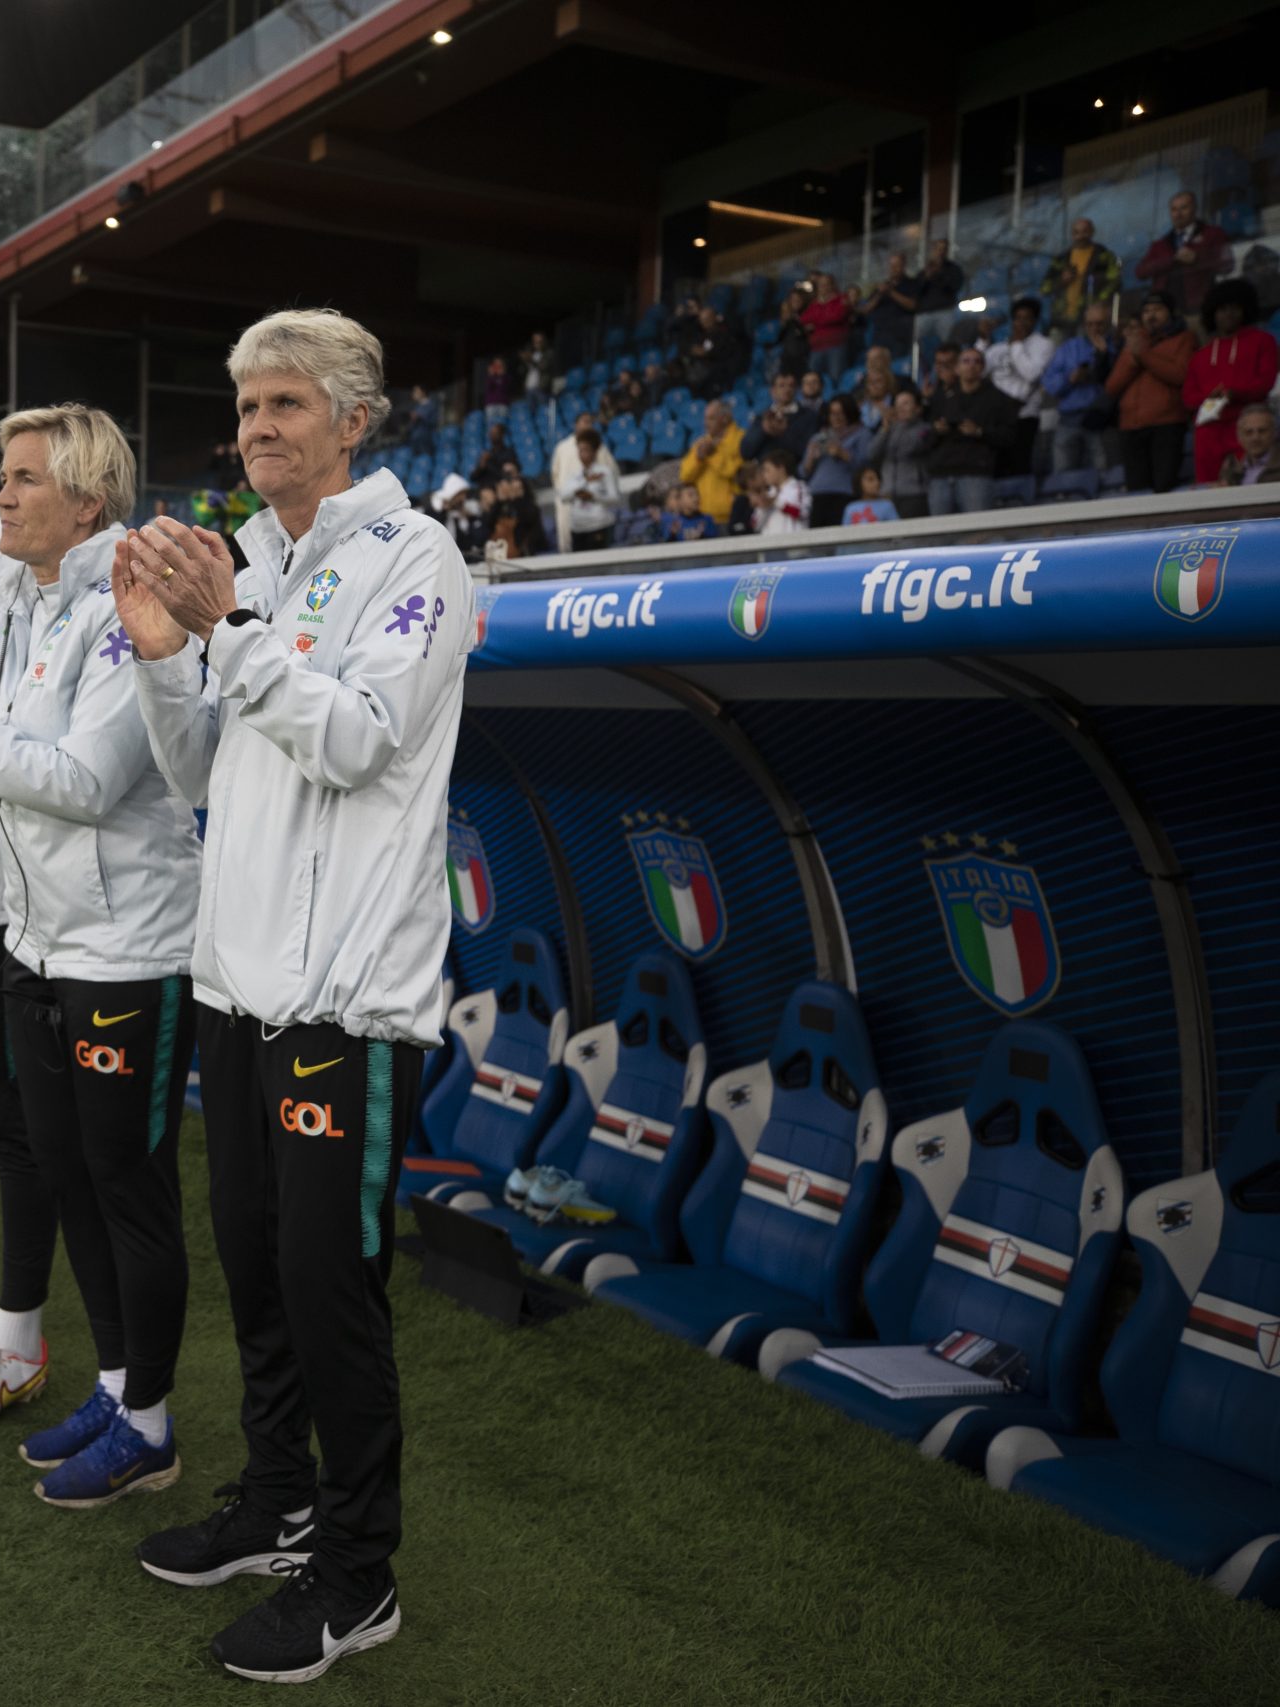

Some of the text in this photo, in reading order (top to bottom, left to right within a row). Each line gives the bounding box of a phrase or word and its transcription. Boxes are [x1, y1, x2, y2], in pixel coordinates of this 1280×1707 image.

[1169, 539, 1227, 554] ITALIA
[861, 550, 1041, 623] figc.it
[297, 613, 324, 624] BRASIL
[546, 580, 663, 639] figc.it
[636, 840, 701, 862] ITALIA
[939, 868, 1031, 897] ITALIA
[75, 1040, 134, 1075] GOL
[279, 1097, 344, 1137] GOL
